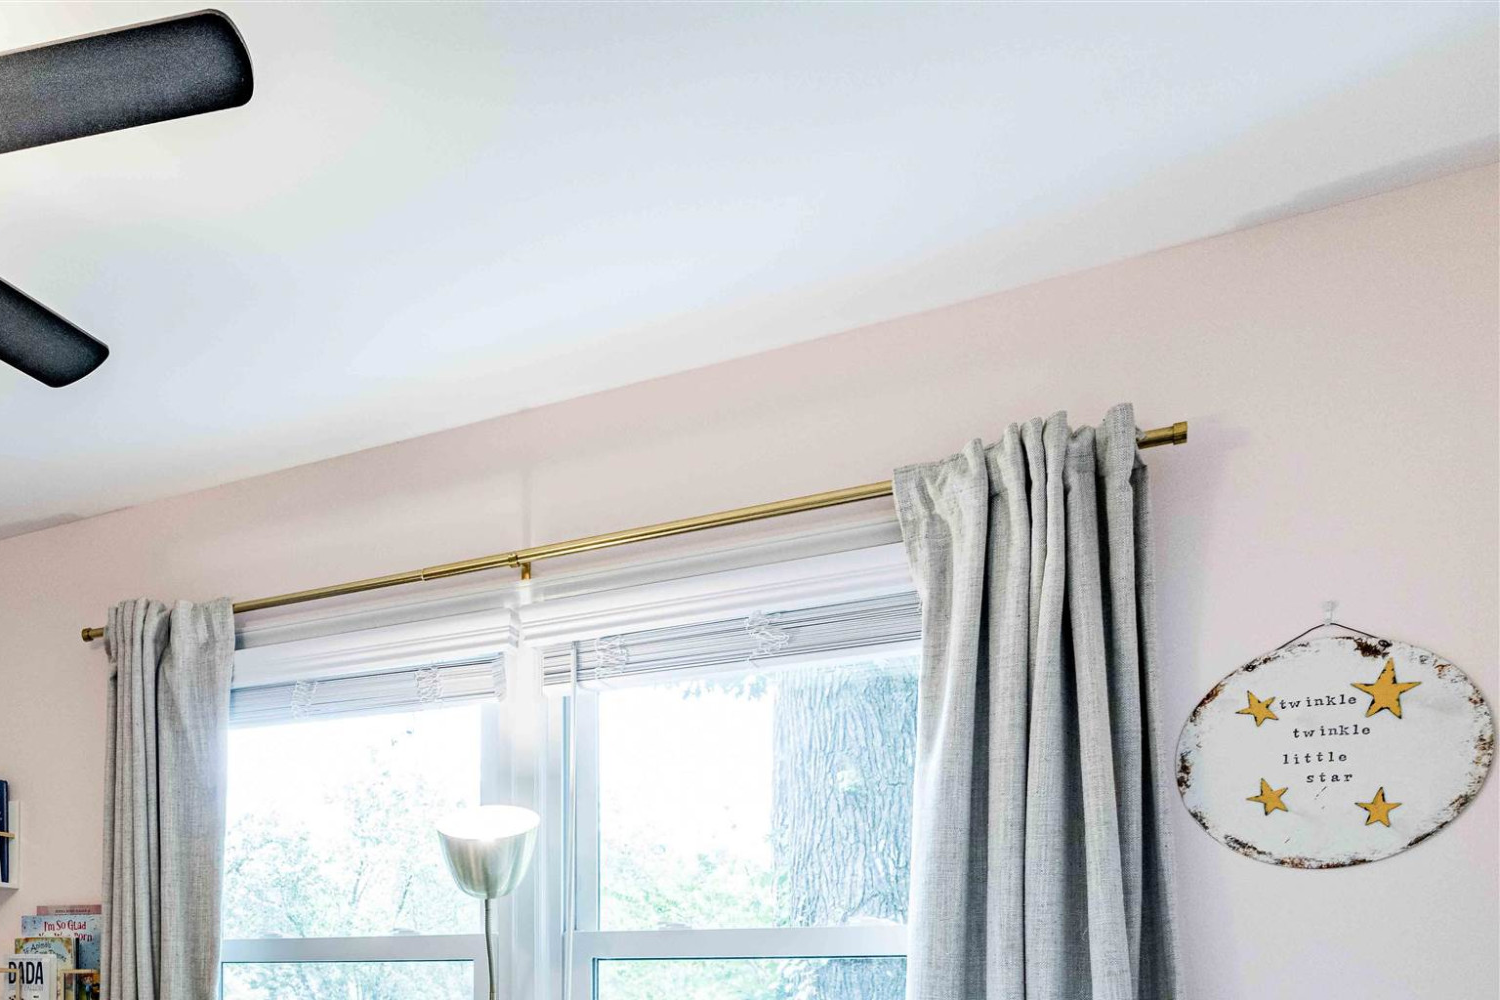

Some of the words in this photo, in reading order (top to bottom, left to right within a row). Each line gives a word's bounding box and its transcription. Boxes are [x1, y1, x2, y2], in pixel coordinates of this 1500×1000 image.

[1279, 694, 1357, 709] twinkle
[1293, 724, 1371, 738] twinkle
[1283, 751, 1347, 765] little
[1306, 772, 1353, 783] star
[56, 920, 66, 930] So
